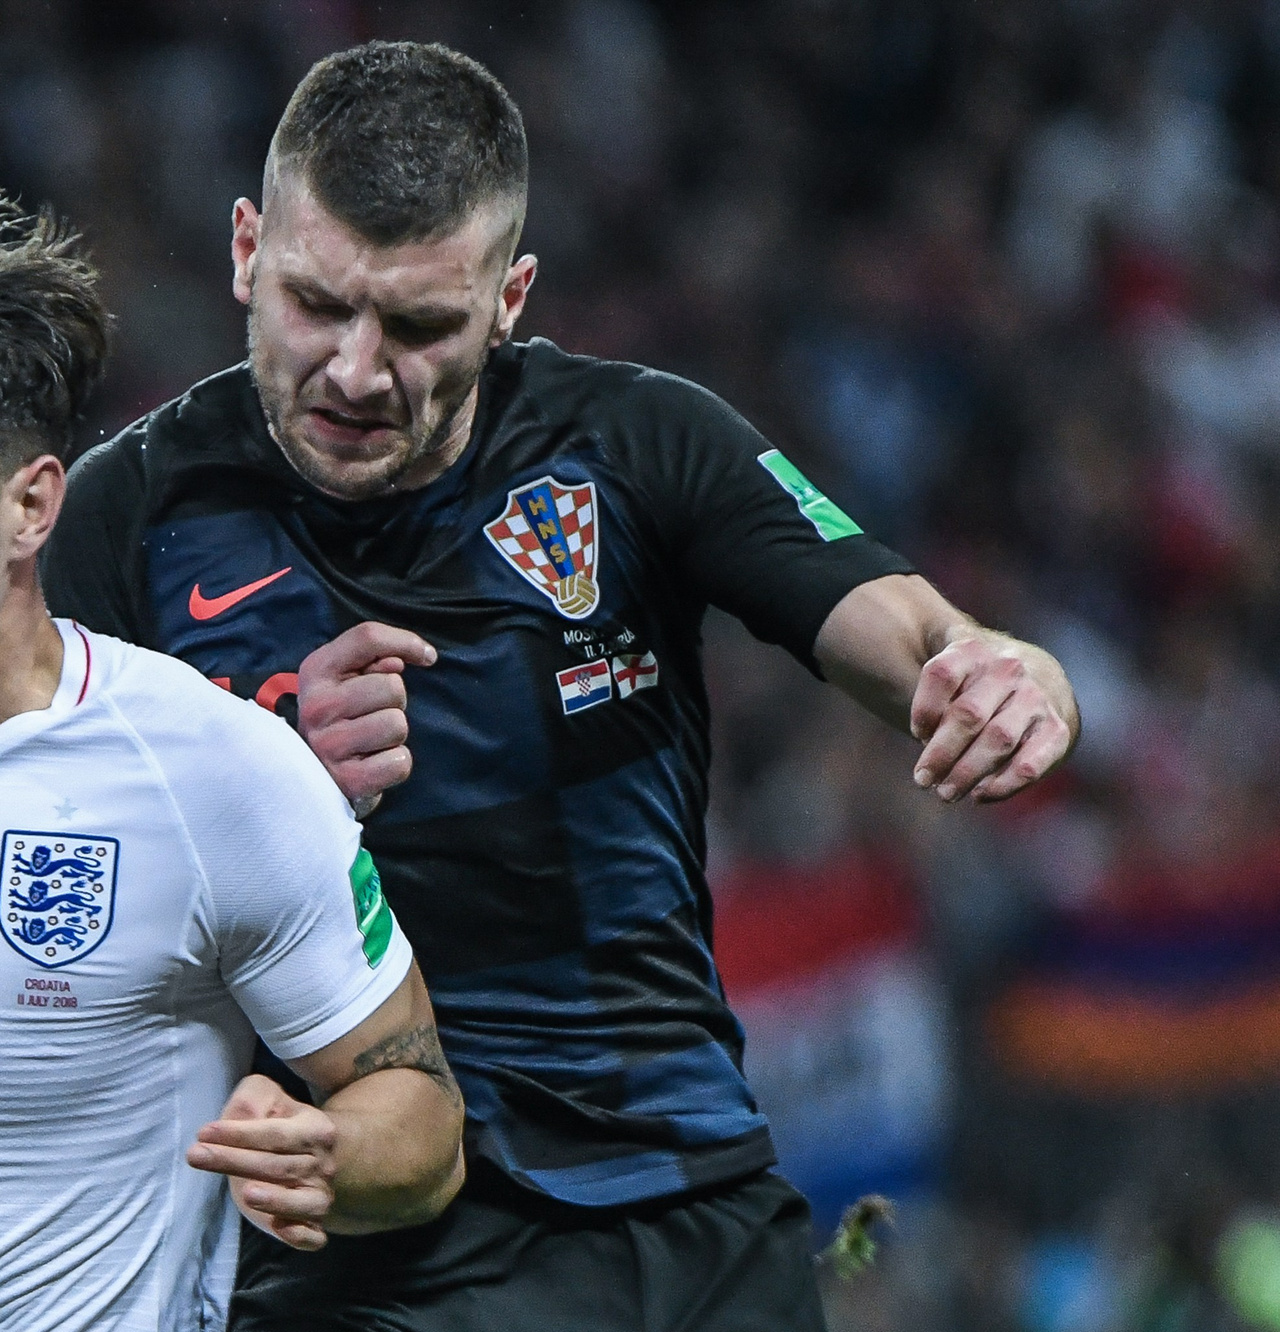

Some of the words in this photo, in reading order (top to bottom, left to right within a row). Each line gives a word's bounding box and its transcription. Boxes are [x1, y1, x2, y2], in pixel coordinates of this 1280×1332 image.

[24, 977, 71, 992] CROATIA
[26, 994, 50, 1007] JULY
[53, 996, 78, 1009] 2018
